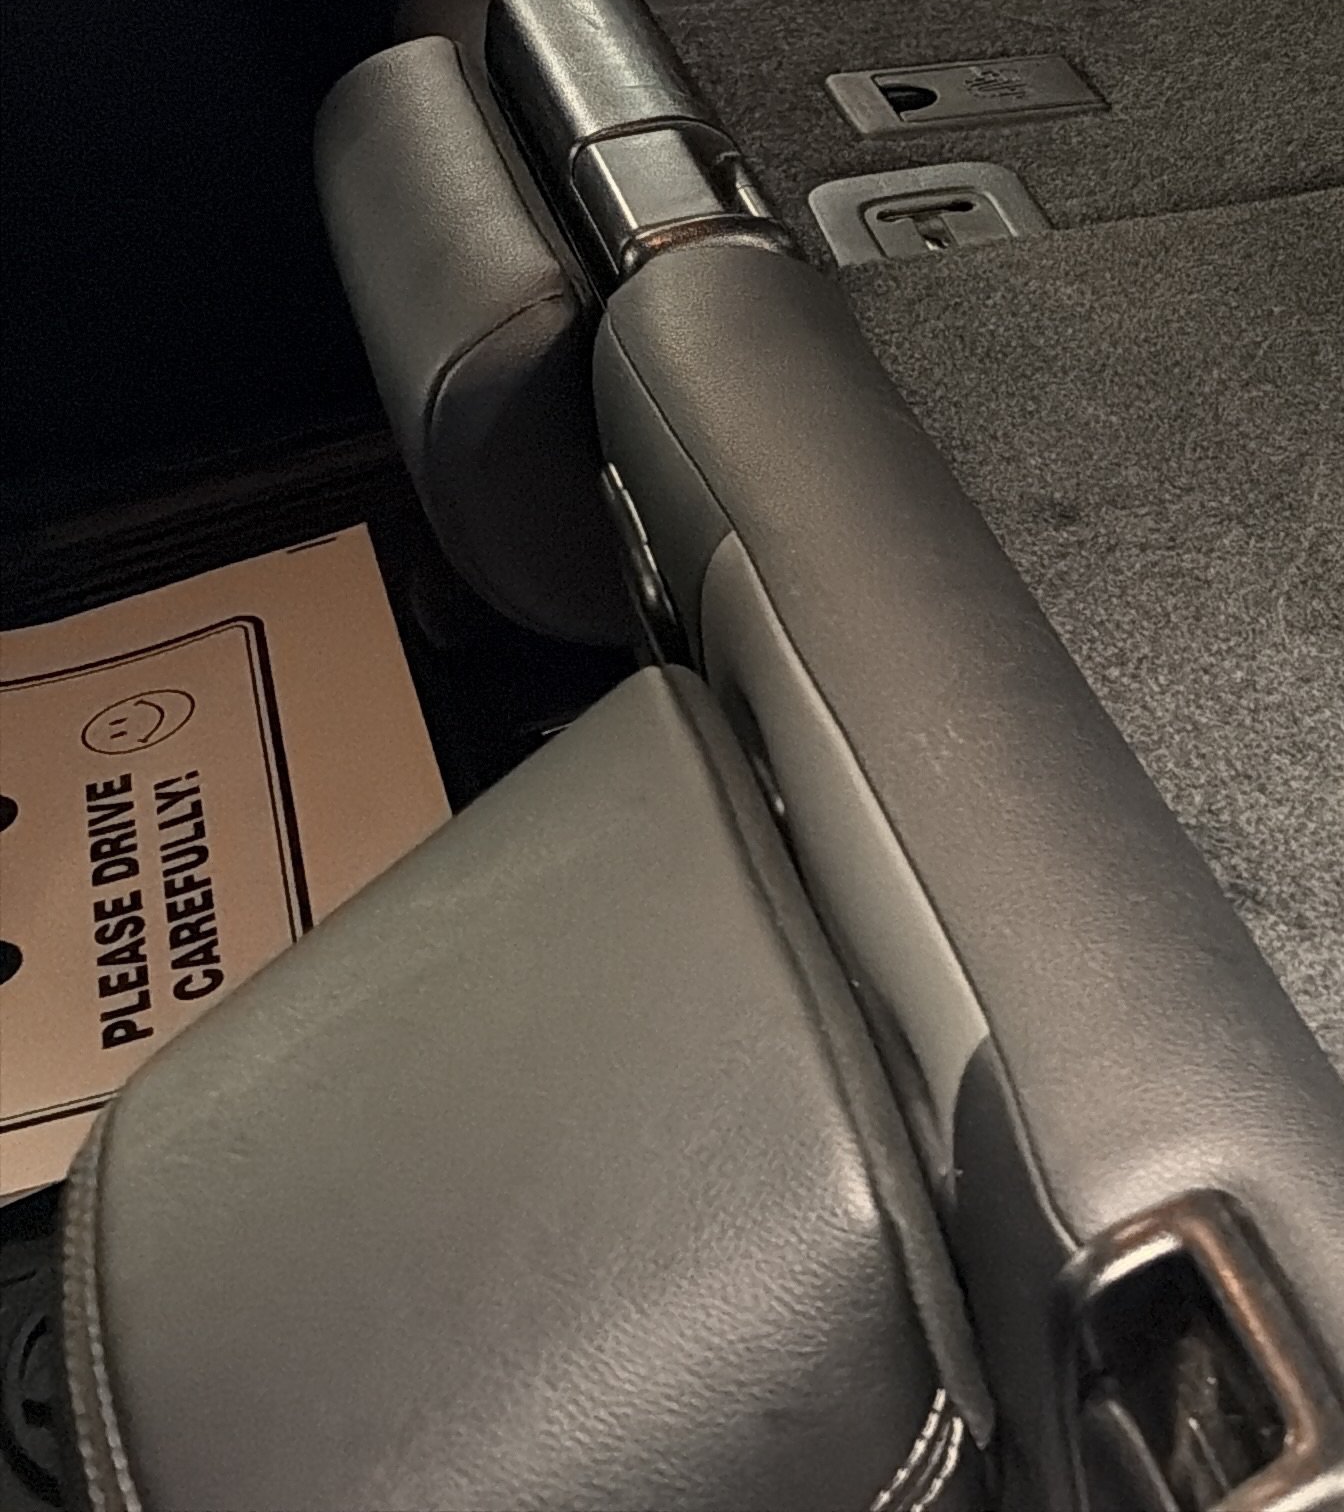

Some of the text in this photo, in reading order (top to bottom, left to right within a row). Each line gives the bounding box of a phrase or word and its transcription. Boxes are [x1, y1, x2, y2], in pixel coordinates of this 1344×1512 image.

[85, 771, 154, 1051] PLEASE DRIVE
[153, 769, 225, 1002] CAREFULLY!
